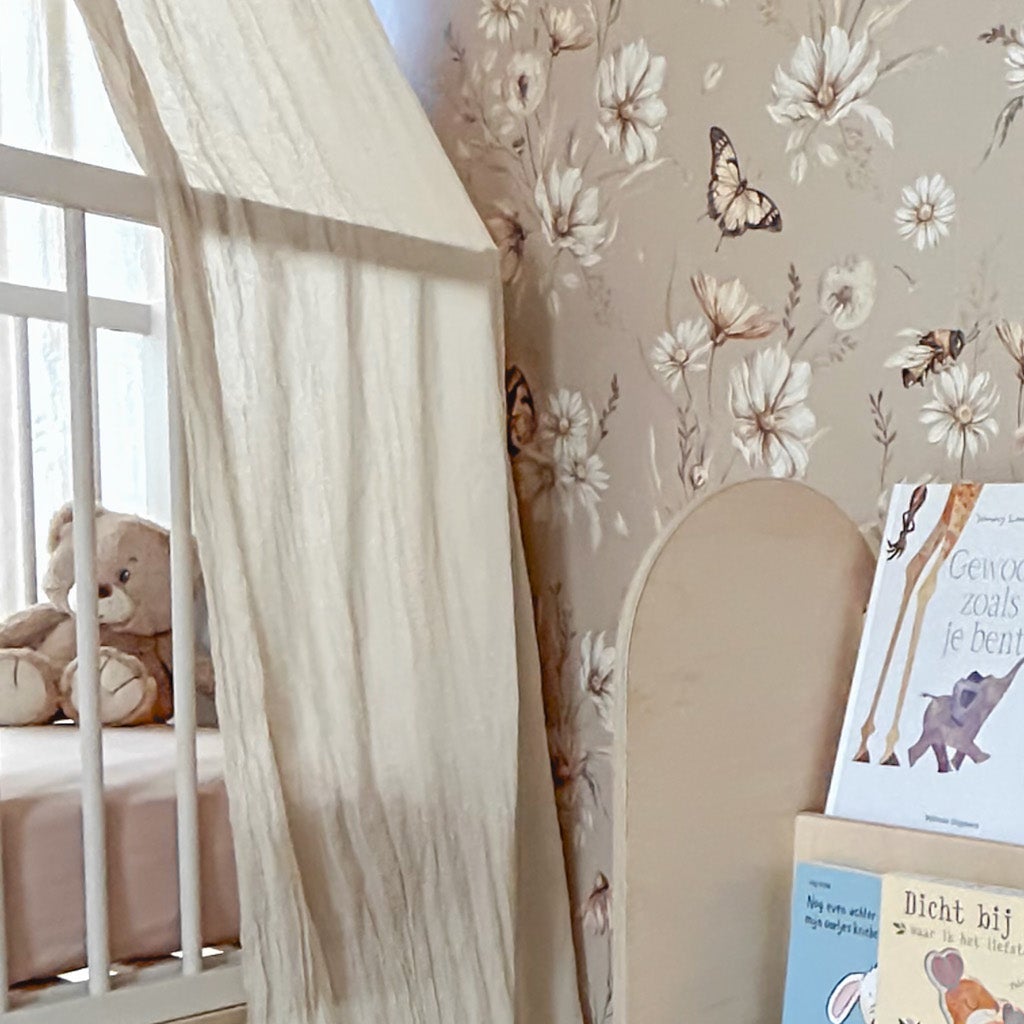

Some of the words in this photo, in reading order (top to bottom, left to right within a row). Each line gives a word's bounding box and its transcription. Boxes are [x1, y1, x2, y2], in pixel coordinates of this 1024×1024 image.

[960, 585, 1020, 619] zoals
[942, 621, 964, 657] je
[970, 621, 1024, 656] bent
[905, 890, 965, 924] Dicht
[977, 903, 1012, 940] bij
